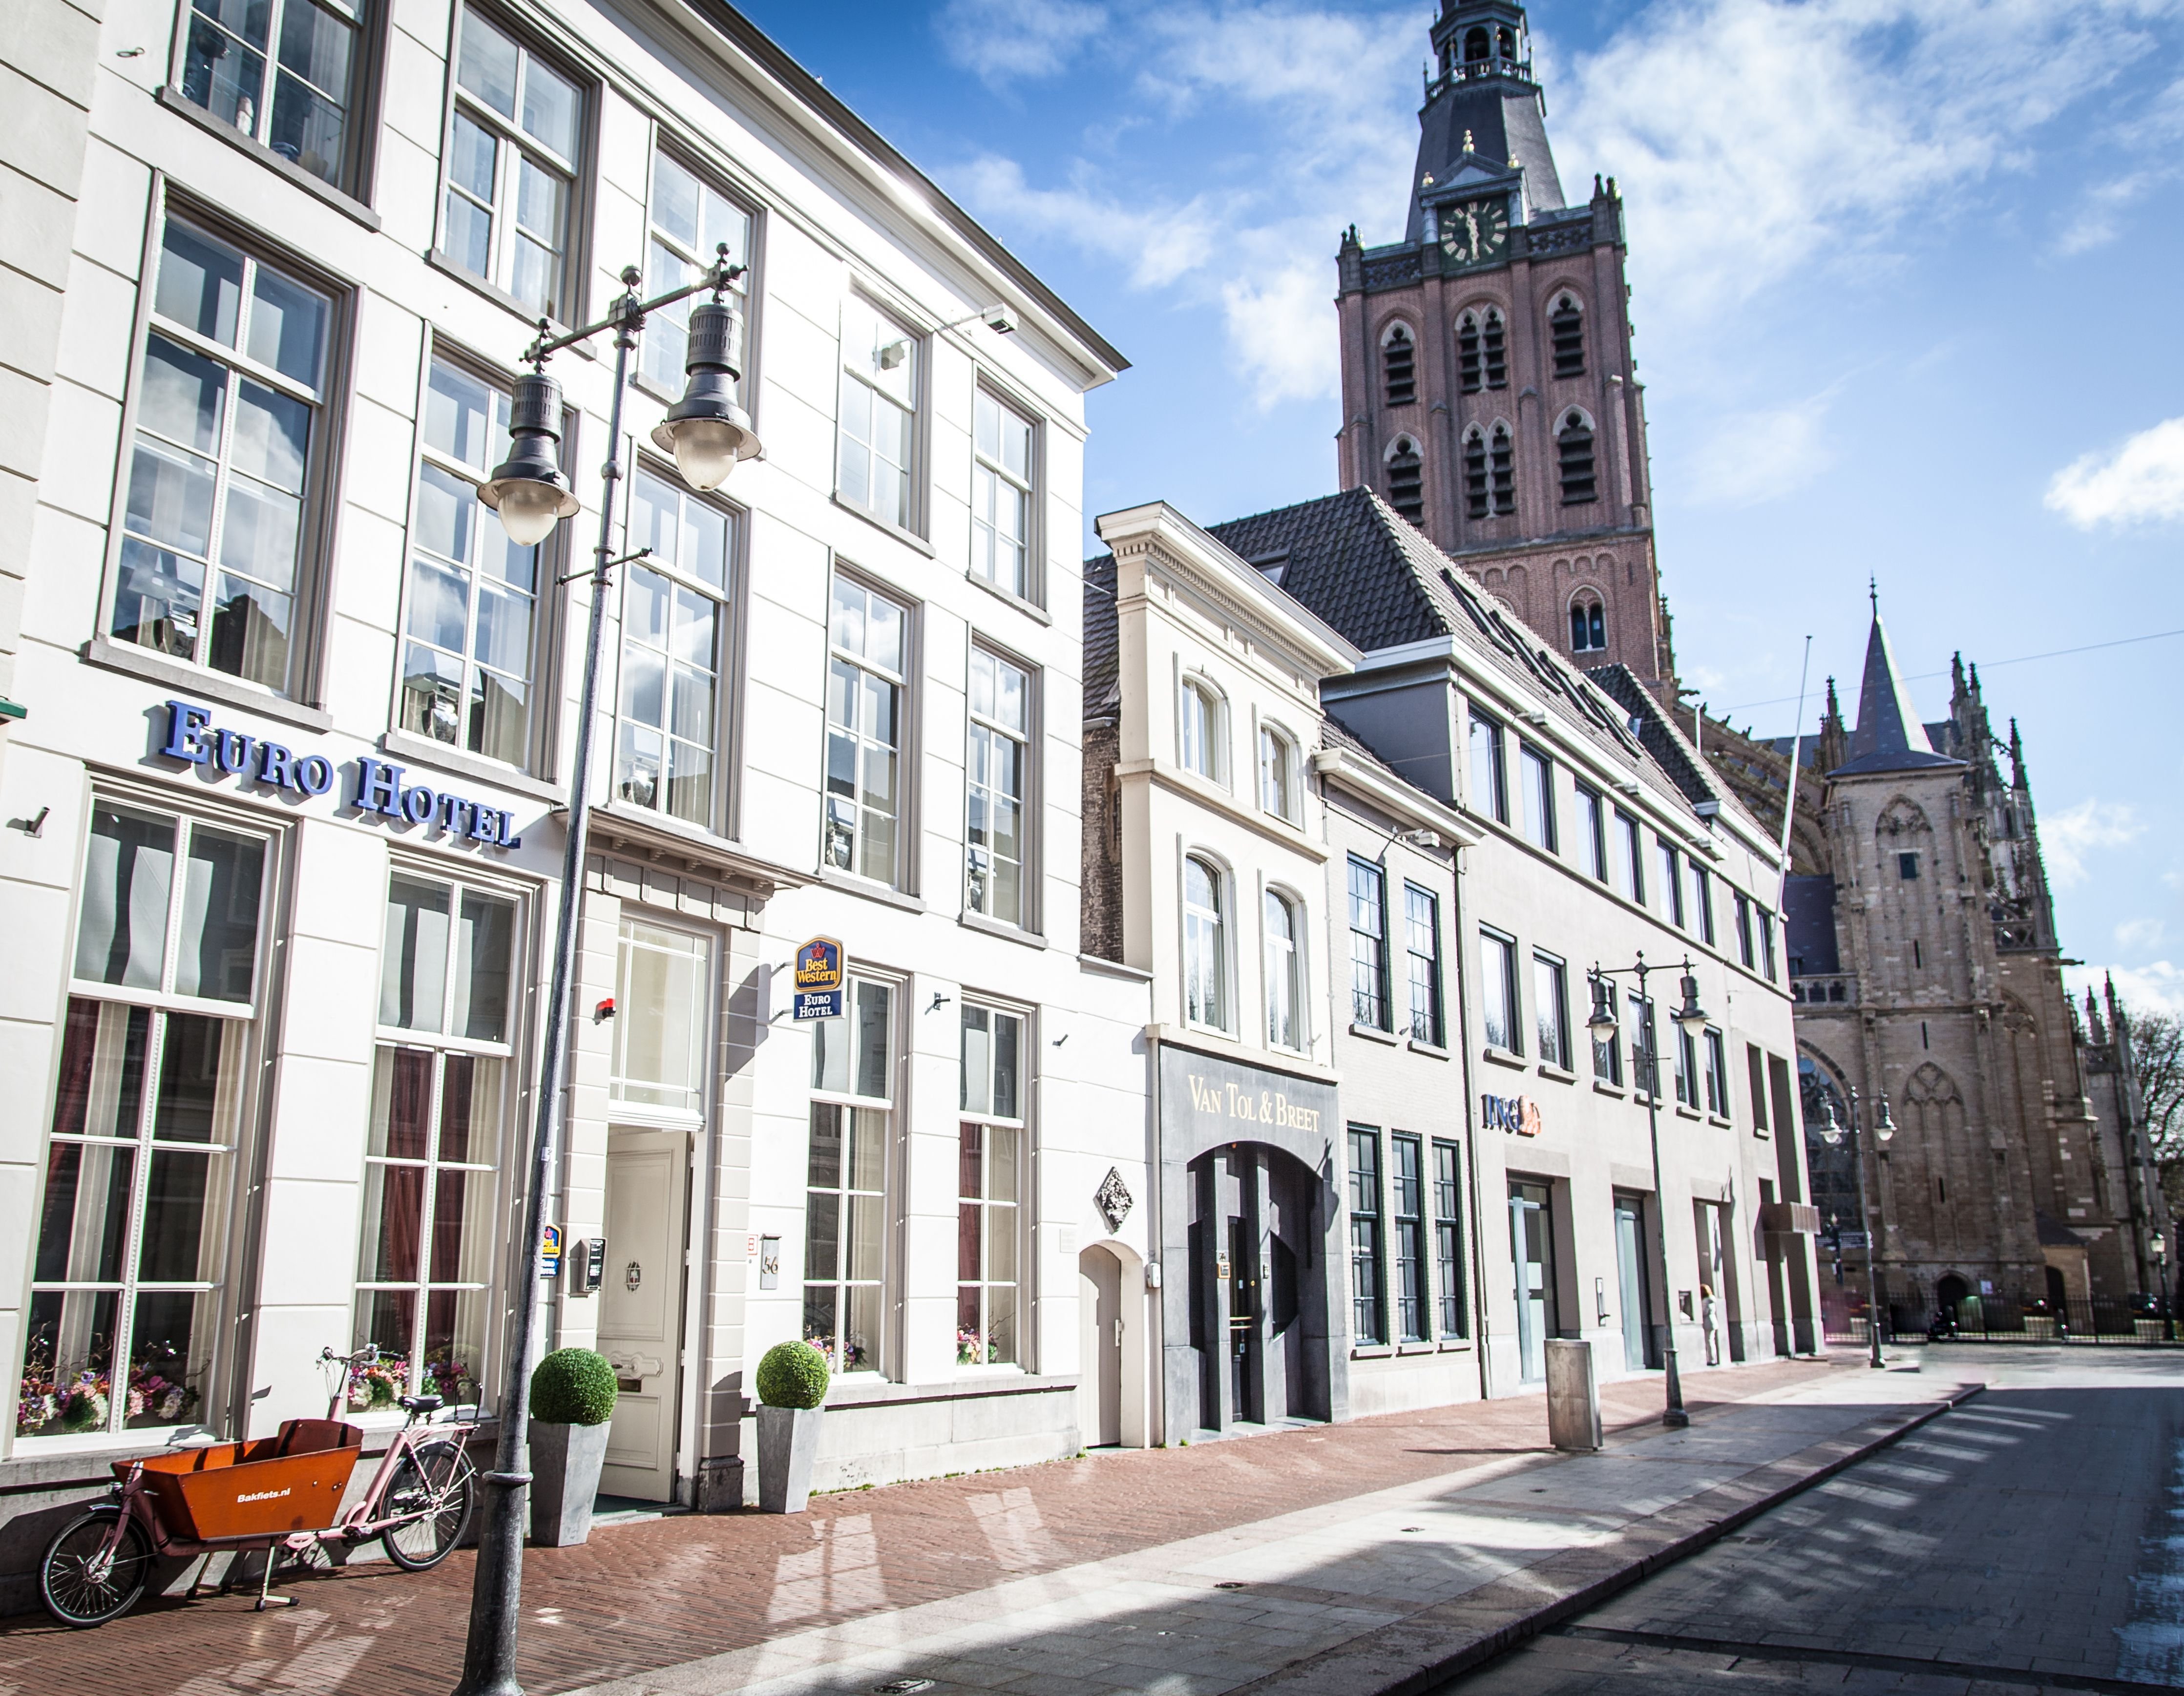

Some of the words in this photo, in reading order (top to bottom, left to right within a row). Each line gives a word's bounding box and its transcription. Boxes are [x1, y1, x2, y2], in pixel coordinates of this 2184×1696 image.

[159, 699, 334, 796] EURO
[351, 756, 521, 849] HOTEL
[805, 957, 828, 972] Best
[797, 970, 837, 984] Western
[803, 994, 831, 1006] EURO
[798, 1005, 833, 1018] HOTEL
[1188, 1074, 1222, 1114] VAN
[1226, 1082, 1257, 1121] TOL
[1259, 1090, 1274, 1124] &
[1275, 1092, 1320, 1132] BREET
[1485, 1093, 1520, 1130] ING
[761, 1256, 778, 1275] 56
[237, 1487, 291, 1503] Bakfiets.nl
